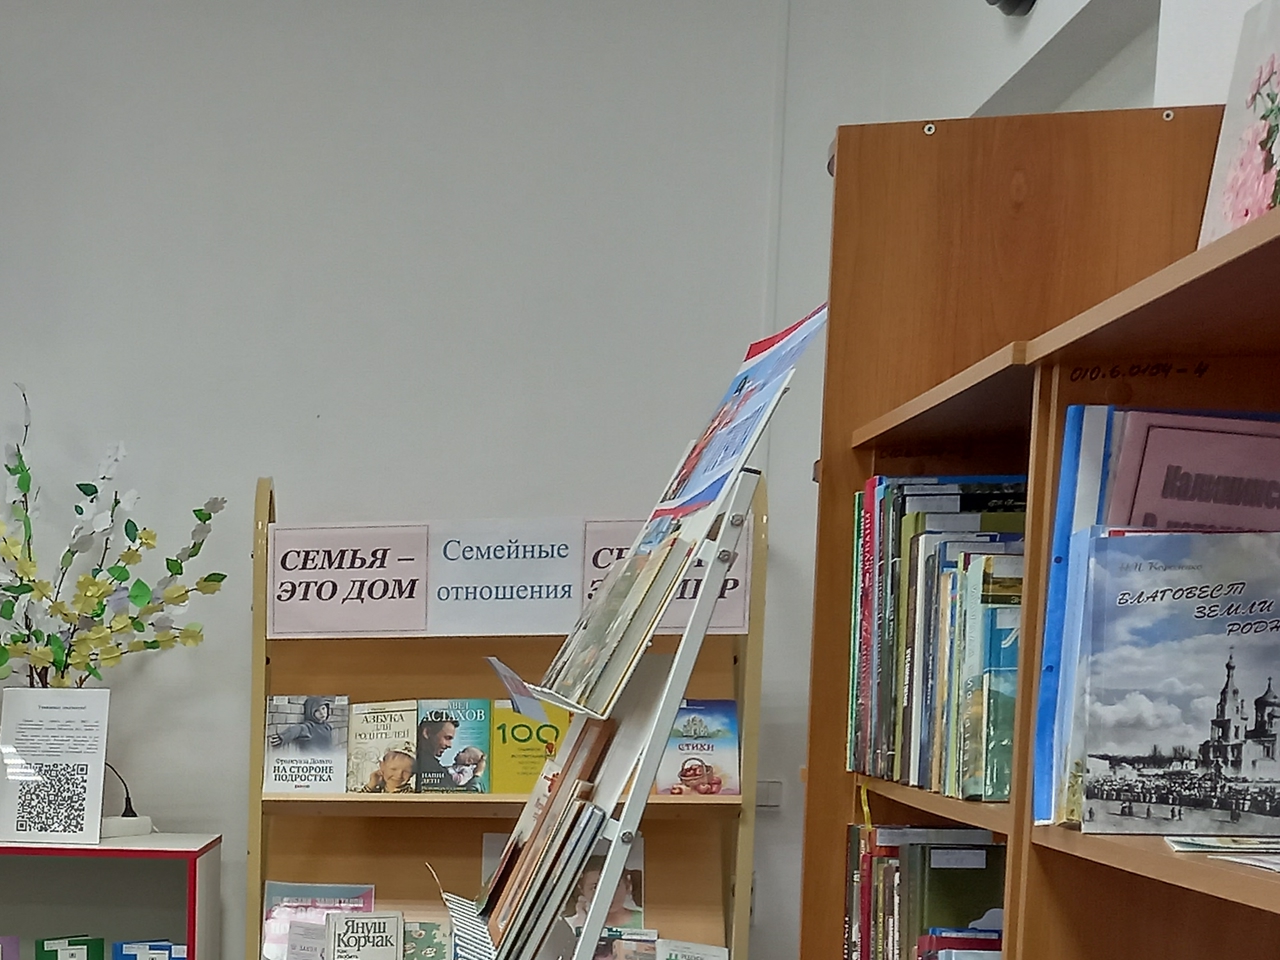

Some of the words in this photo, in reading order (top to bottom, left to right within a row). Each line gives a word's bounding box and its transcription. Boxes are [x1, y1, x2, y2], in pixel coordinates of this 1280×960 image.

[280, 548, 390, 571] СЕМЬЯ
[442, 539, 570, 562] Семейные
[276, 580, 338, 602] ЭТО
[341, 577, 419, 604] ДОМ
[436, 583, 573, 602] отношения
[1117, 581, 1246, 606] БЛАГОВЕСТ
[1193, 599, 1275, 619] ЗЕМЛИ
[360, 714, 405, 724] АЗБУКА
[423, 709, 485, 722] АСТАХОВ
[374, 723, 392, 732] ДЛЯ
[497, 722, 560, 744] 100
[678, 743, 714, 752] СТИХИ
[273, 766, 288, 774] НА
[289, 765, 334, 774] СТОРОНЕ
[274, 773, 332, 782] ПОДРОСТКА
[344, 919, 387, 935] Януш
[336, 933, 395, 951] Корчак
